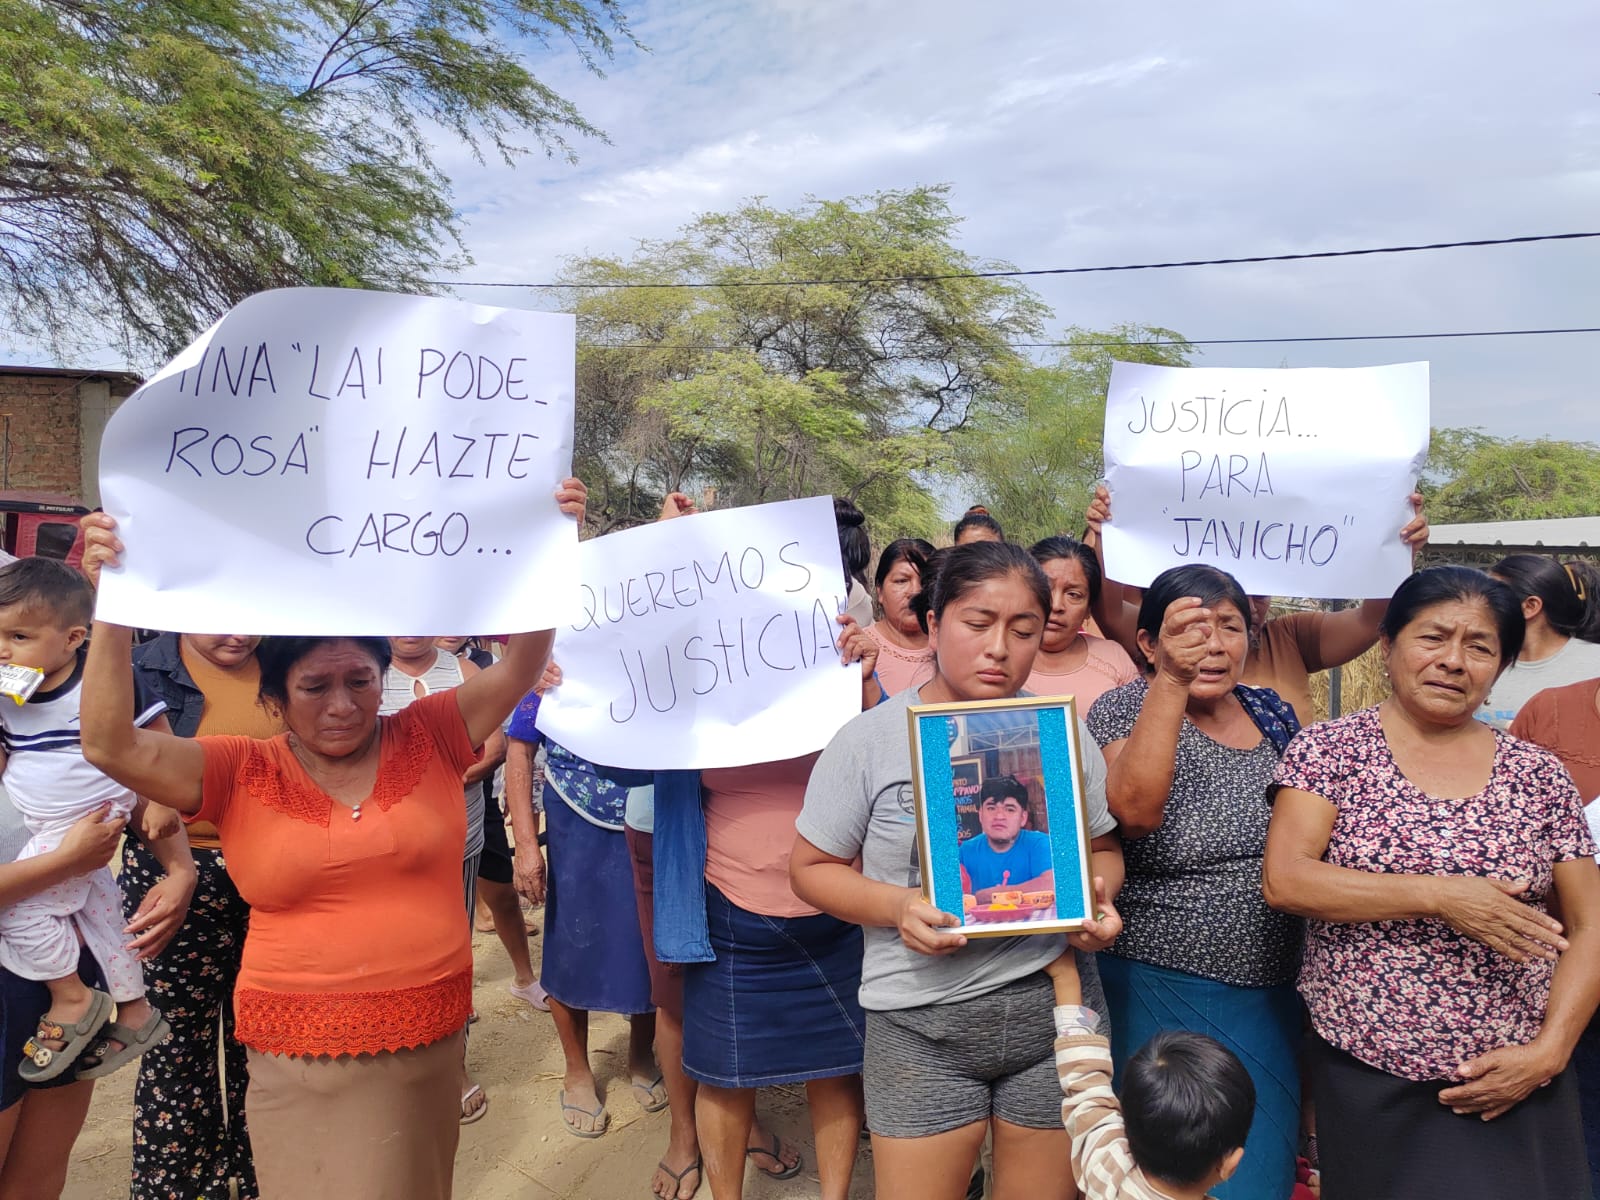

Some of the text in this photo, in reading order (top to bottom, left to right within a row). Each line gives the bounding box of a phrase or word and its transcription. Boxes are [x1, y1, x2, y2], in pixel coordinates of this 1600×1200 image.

[366, 426, 539, 480] HAZTE
[1181, 450, 1274, 502] PARA
[306, 511, 512, 559] CARGO...
[571, 541, 811, 632] QUEREMOS
